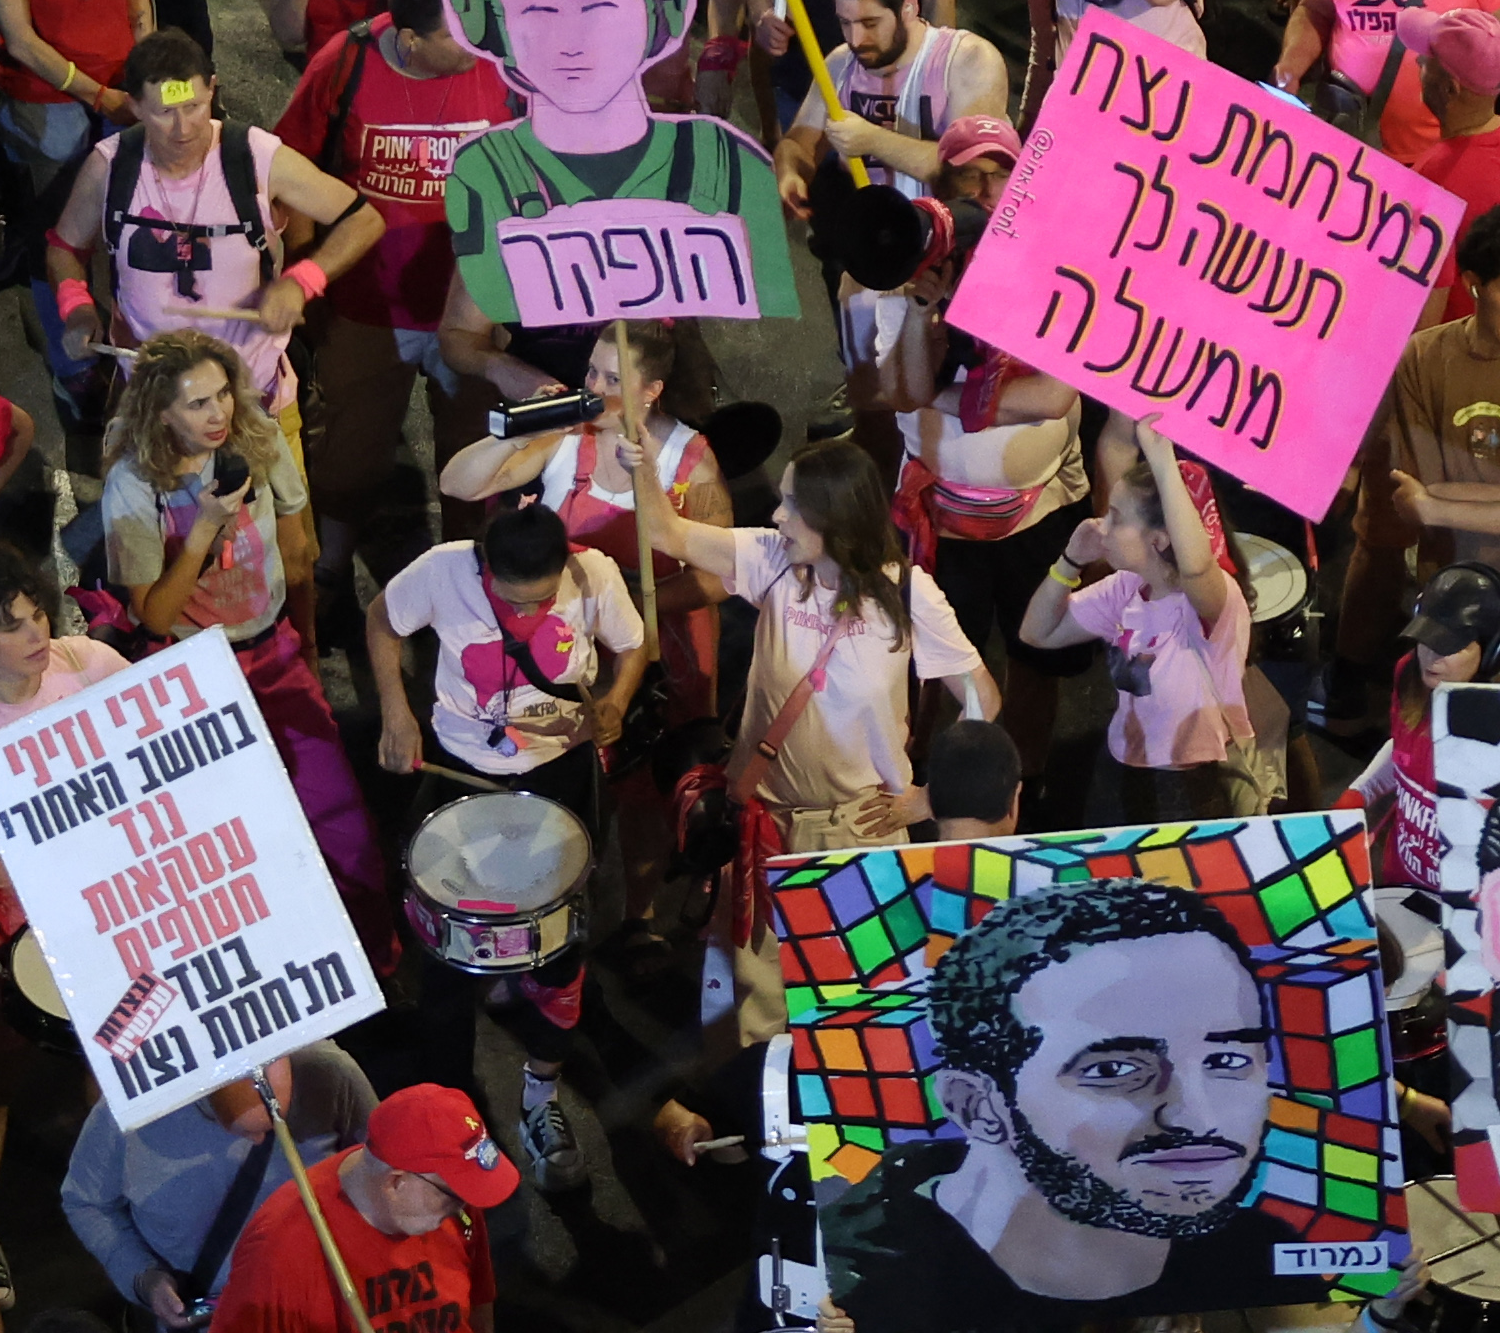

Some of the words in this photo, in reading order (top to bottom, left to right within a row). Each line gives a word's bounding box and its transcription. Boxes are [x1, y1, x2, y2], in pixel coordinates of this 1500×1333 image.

[1073, 33, 1190, 146] נצח
[1113, 160, 1173, 273] לך
[1191, 103, 1442, 289] במלחמת
[501, 224, 747, 318] הופקר
[1180, 201, 1342, 345] תעשה
[1034, 265, 1283, 446] ממשלה
[108, 662, 210, 728] ביבי
[145, 701, 259, 790] במושב
[80, 818, 259, 937] עסקאות
[108, 792, 185, 859] נגד
[111, 875, 272, 984] חטופים
[162, 941, 262, 1010] בעד
[111, 1019, 203, 1101] נצח
[211, 949, 358, 1063] מלחמת
[1280, 1246, 1382, 1270] נמרוד
